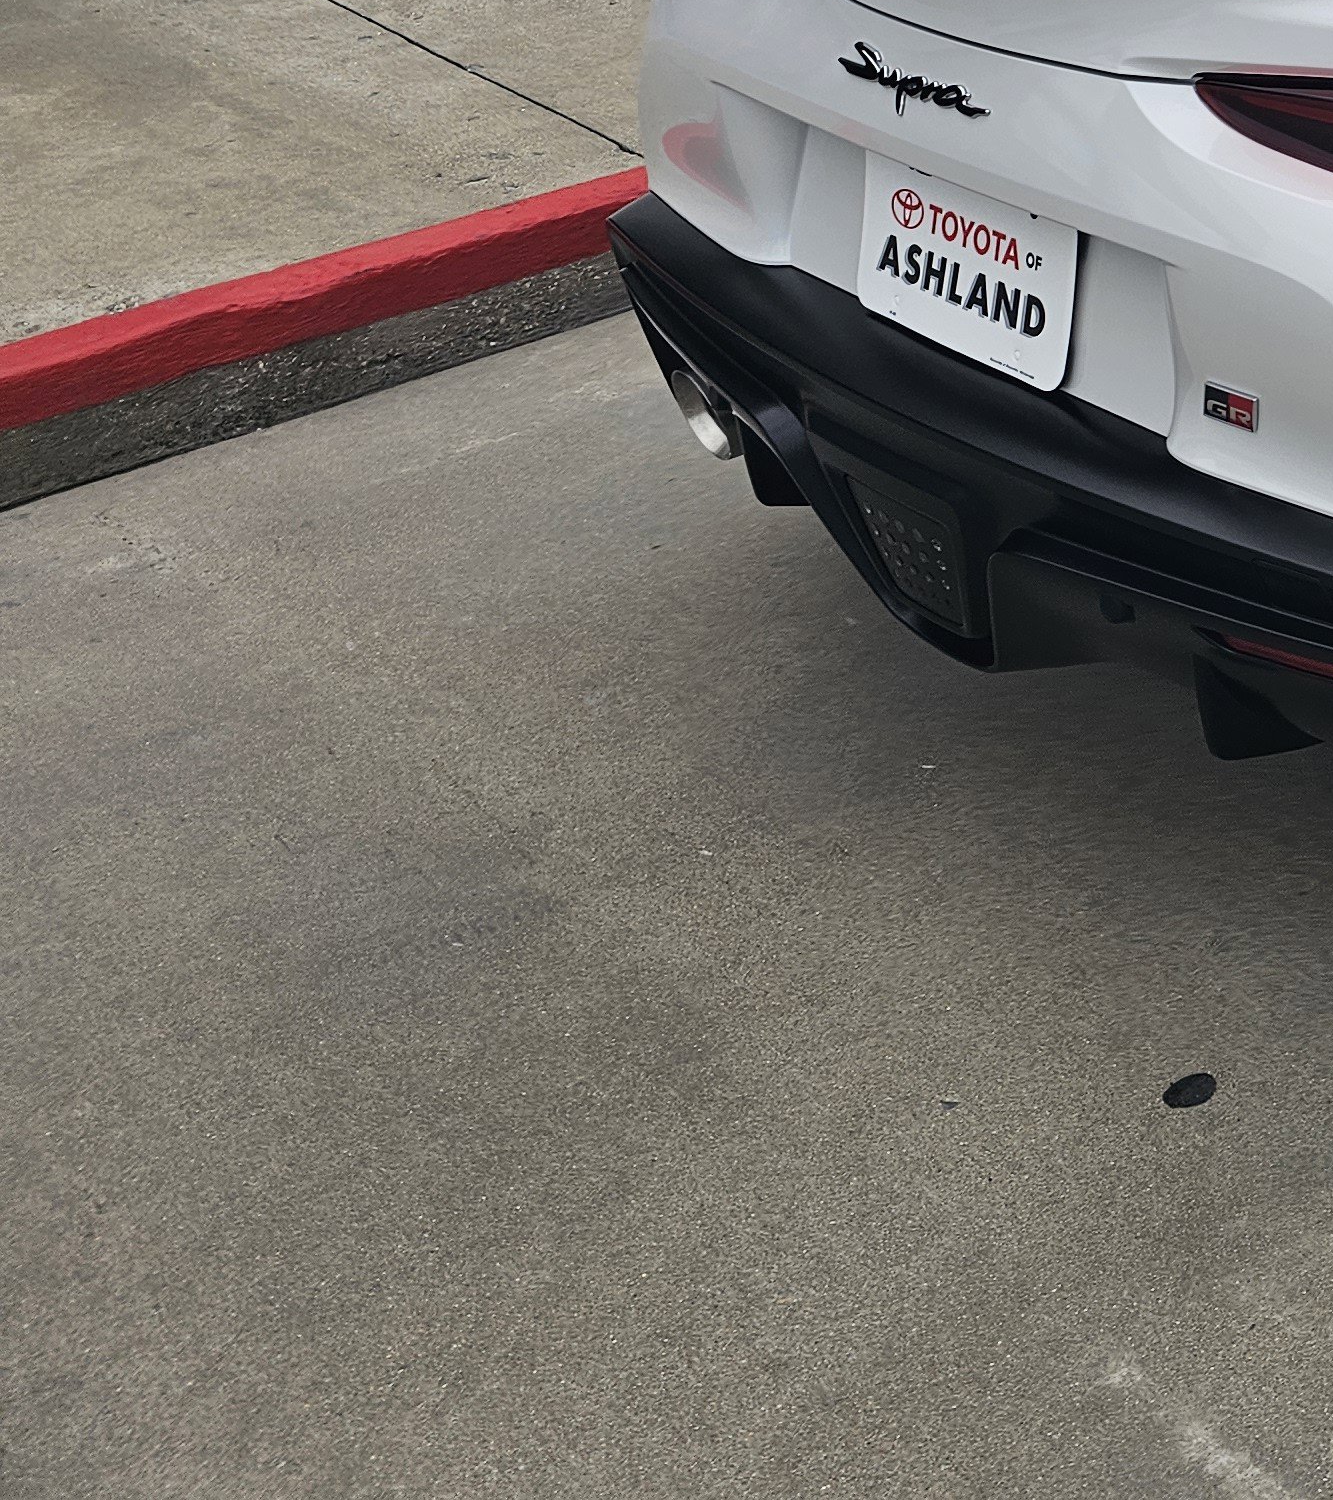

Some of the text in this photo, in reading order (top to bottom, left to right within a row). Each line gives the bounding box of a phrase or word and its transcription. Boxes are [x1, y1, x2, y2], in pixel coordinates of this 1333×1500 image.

[837, 41, 991, 119] Supra
[928, 202, 1043, 272] TOYOTA OF
[876, 234, 1047, 338] ASHLAND
[1206, 400, 1252, 429] GR
